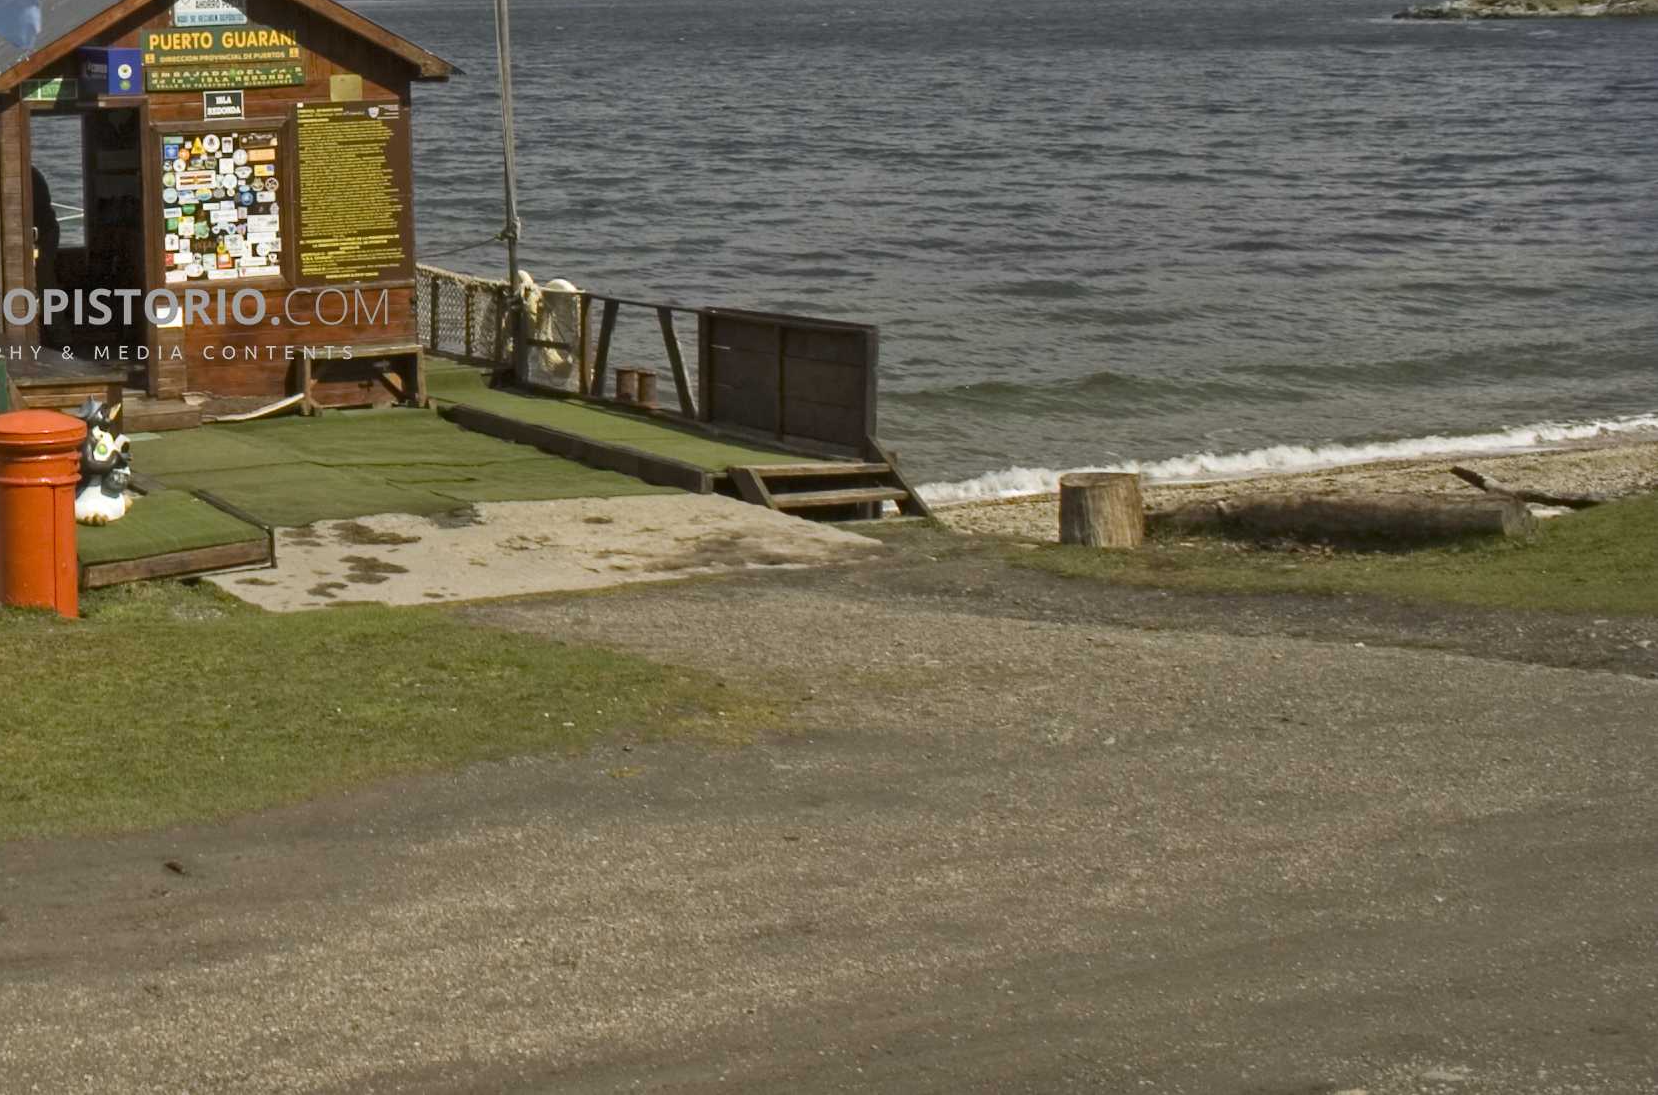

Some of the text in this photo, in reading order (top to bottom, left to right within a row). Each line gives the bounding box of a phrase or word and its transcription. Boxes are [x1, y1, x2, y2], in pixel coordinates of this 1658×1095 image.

[149, 32, 213, 51] PUERTO
[215, 95, 232, 105] ISLA
[206, 105, 242, 116] REDONDA
